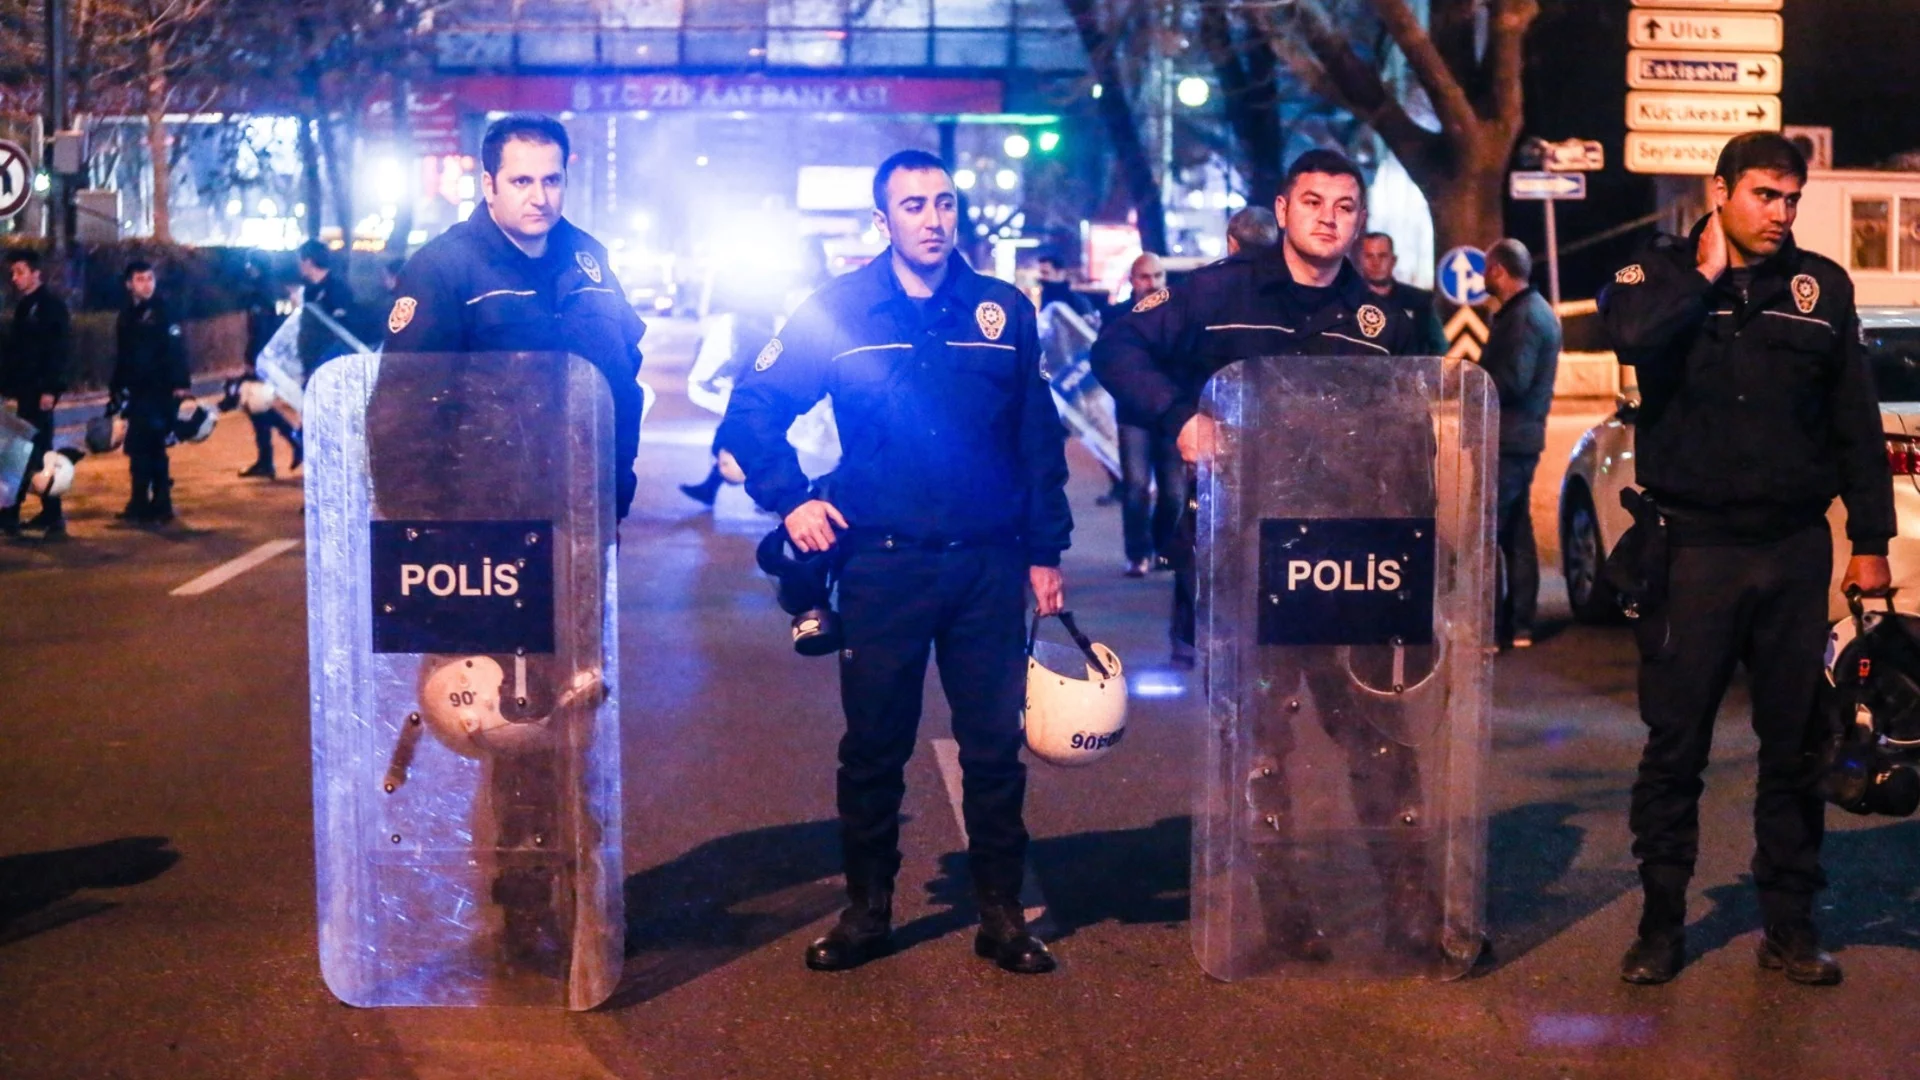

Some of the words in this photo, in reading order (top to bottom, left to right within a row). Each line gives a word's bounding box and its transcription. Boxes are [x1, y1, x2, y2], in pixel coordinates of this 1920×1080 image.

[1670, 21, 1722, 39] Ulus
[400, 557, 519, 597] POLİS
[1287, 553, 1401, 592] POLİS
